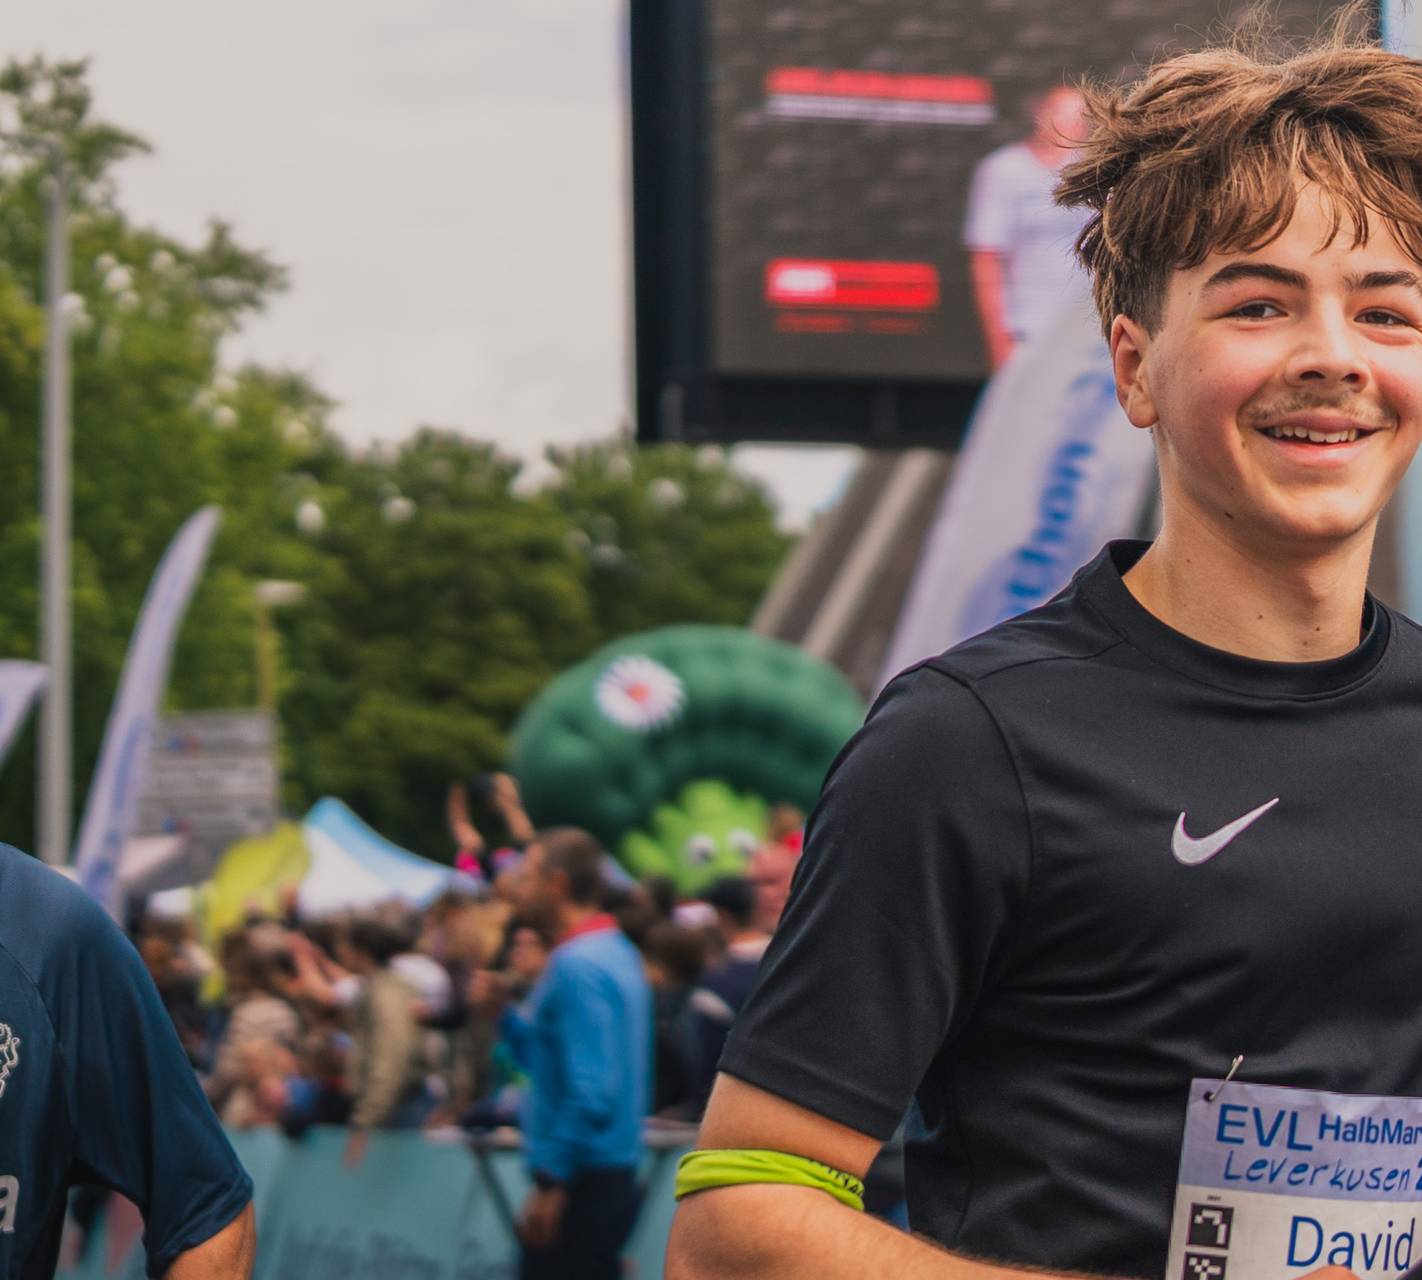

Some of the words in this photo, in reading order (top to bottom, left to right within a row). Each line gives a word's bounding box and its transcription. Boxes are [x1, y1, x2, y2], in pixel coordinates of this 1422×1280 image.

[1216, 1103, 1313, 1151] EVL
[1224, 1151, 1410, 1191] Leverkusen
[1286, 1215, 1416, 1271] David
